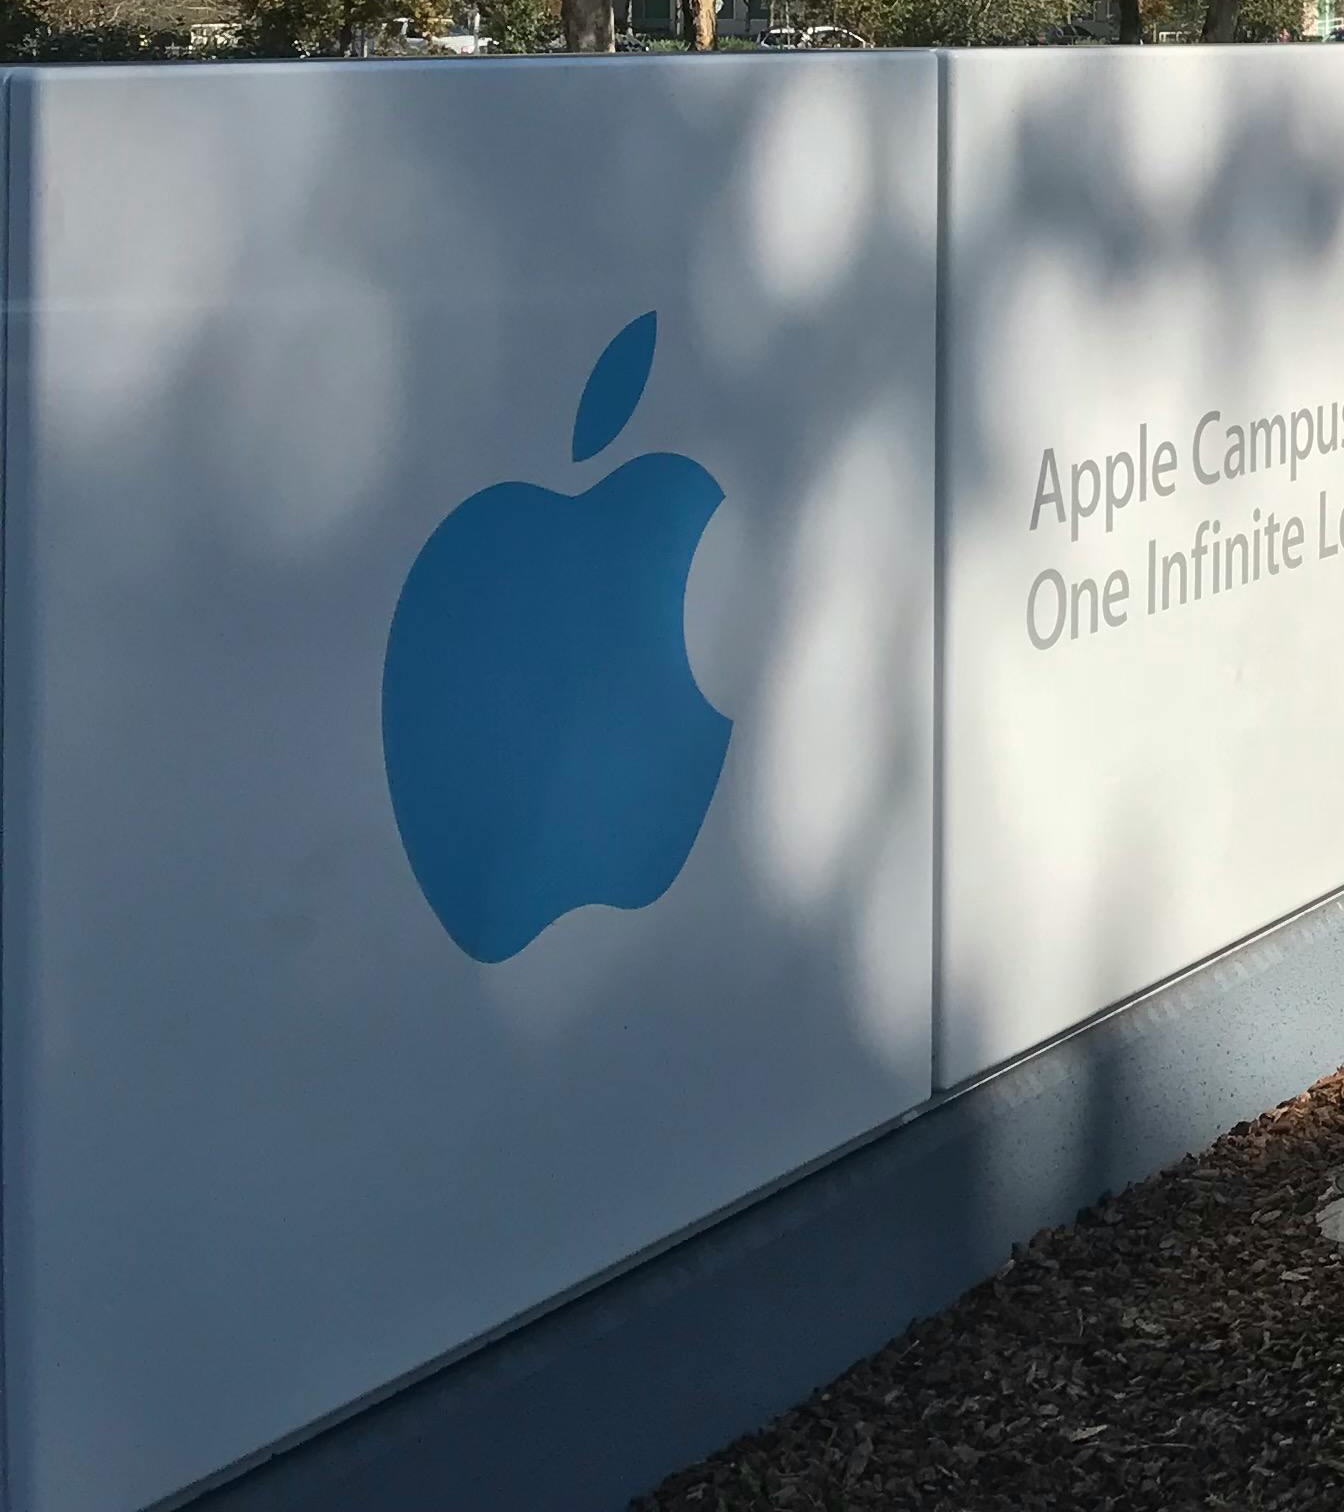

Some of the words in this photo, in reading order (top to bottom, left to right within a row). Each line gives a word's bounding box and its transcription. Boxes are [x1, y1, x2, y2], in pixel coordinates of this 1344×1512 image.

[1029, 423, 1178, 542] Apple
[1026, 568, 1130, 651] One
[1147, 507, 1305, 616] Infinite
